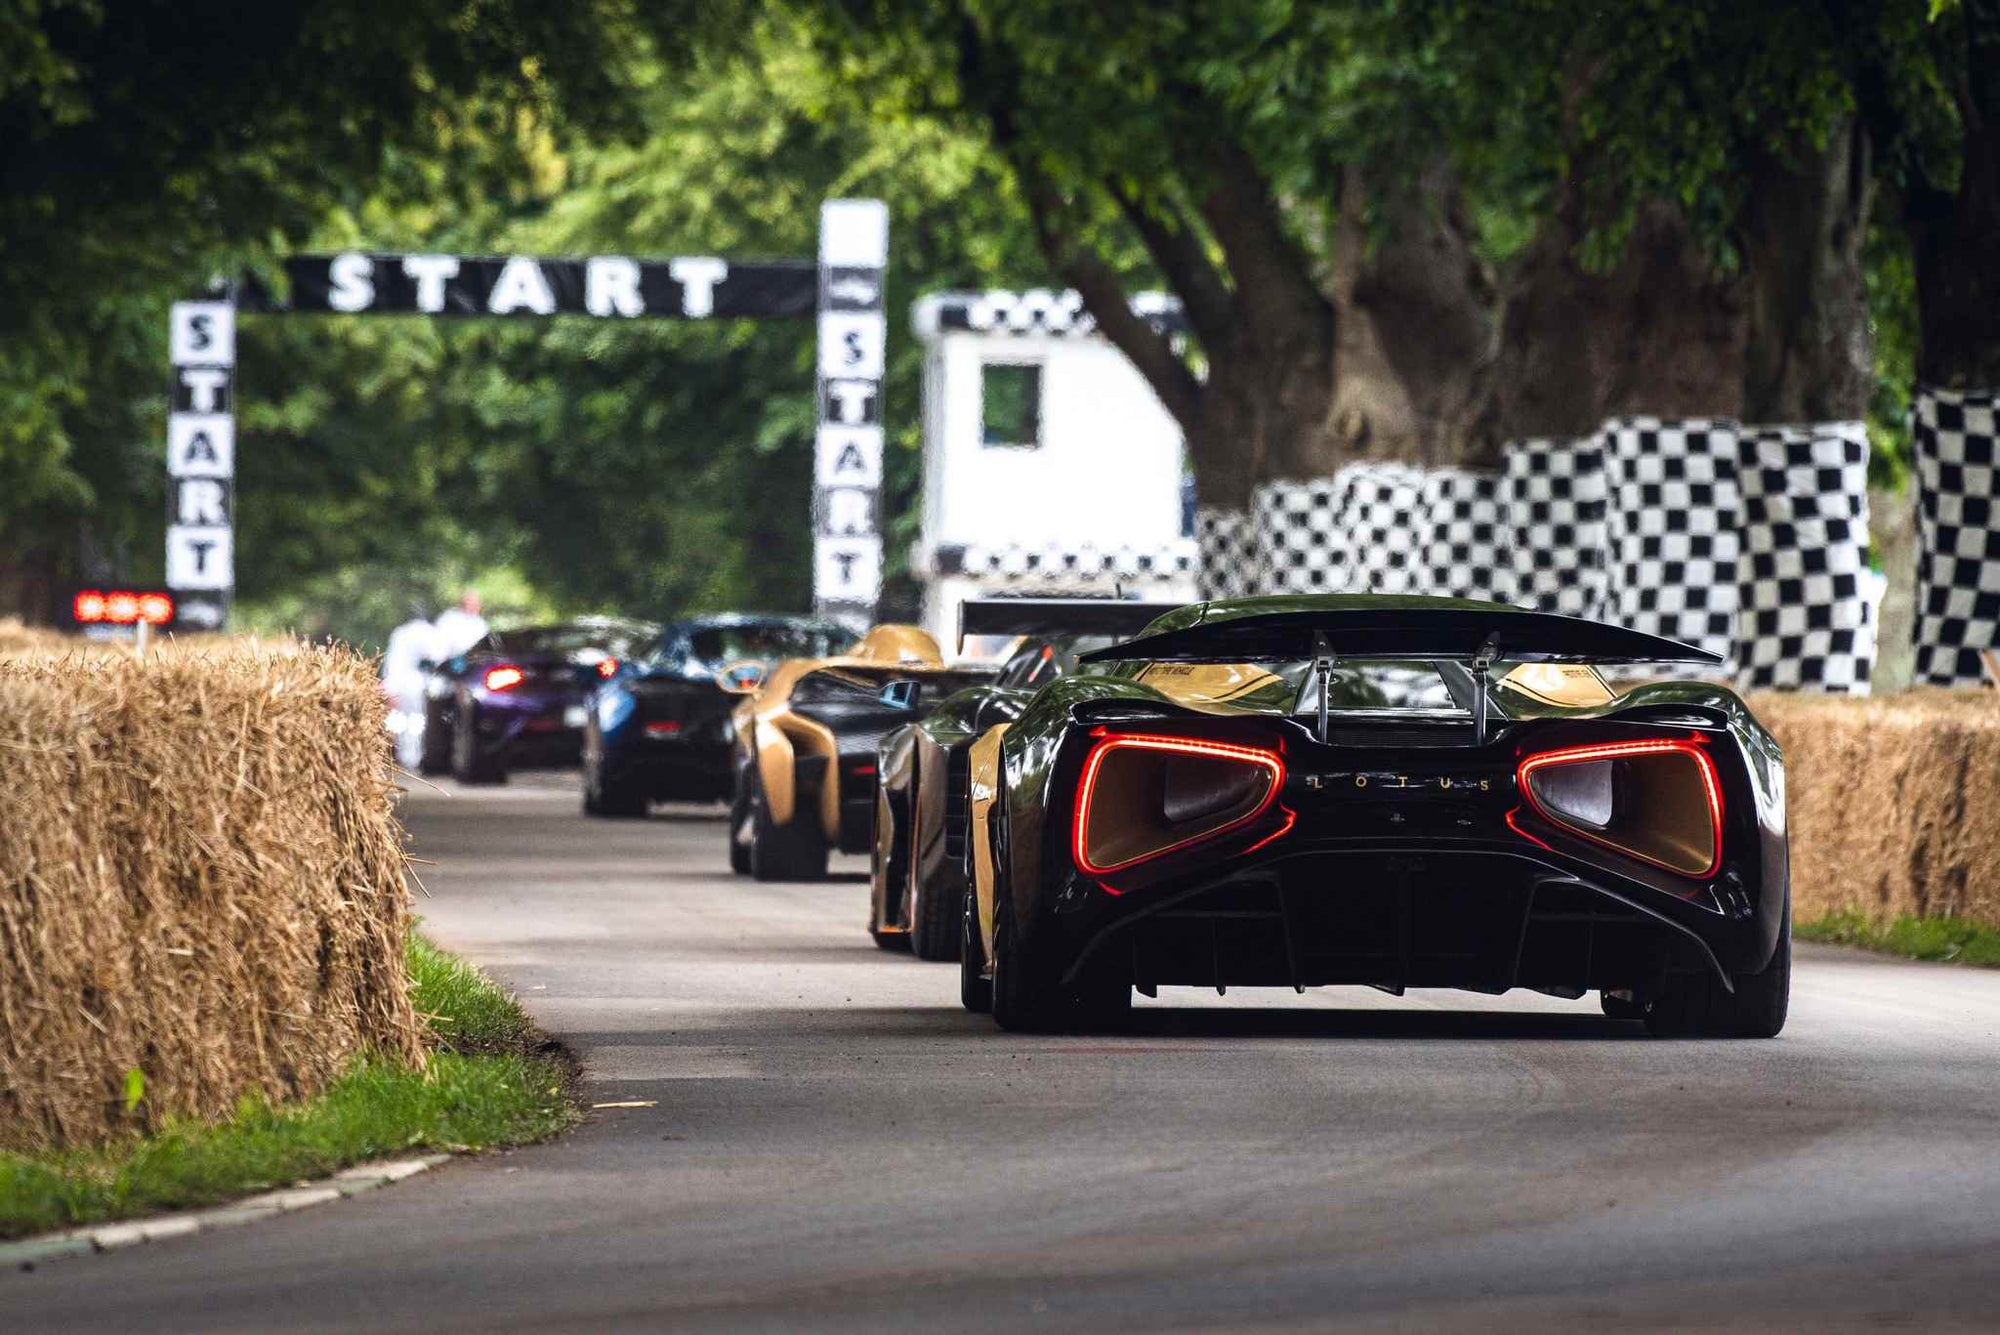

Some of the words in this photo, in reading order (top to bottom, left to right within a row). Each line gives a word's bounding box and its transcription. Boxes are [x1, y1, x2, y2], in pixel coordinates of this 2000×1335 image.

[328, 253, 728, 318] START
[179, 314, 228, 572] START
[827, 330, 876, 584] START
[1314, 775, 1489, 791] LOTUS
